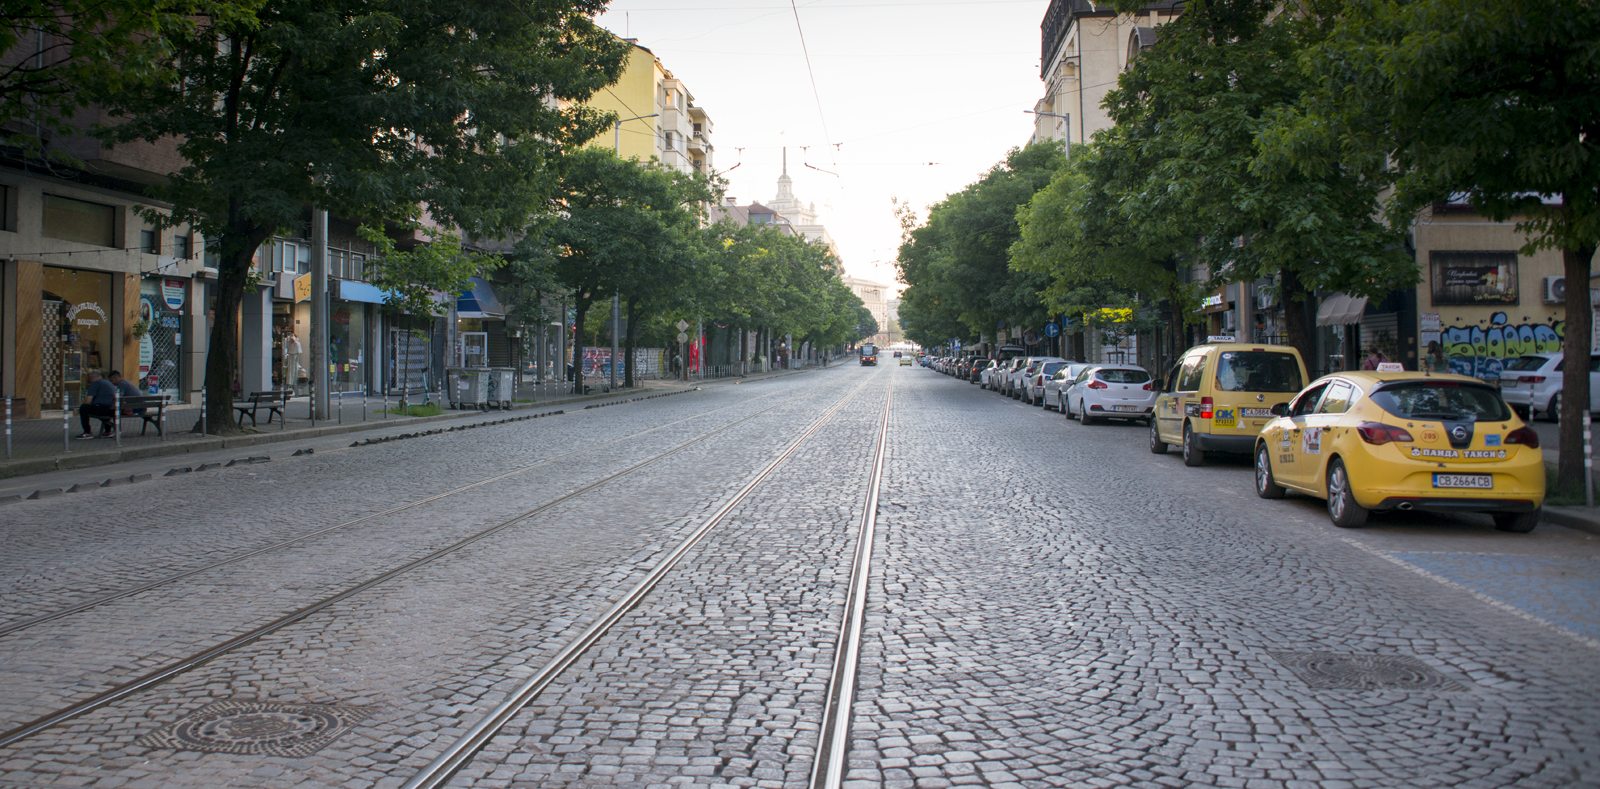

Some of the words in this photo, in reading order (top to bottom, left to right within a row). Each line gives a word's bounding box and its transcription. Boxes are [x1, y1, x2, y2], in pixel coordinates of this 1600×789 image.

[66, 302, 107, 323] Щастливата
[1423, 449, 1459, 458] ПАНДА
[1463, 450, 1496, 459] ТАКСИ
[1453, 476, 1476, 486] 2664
